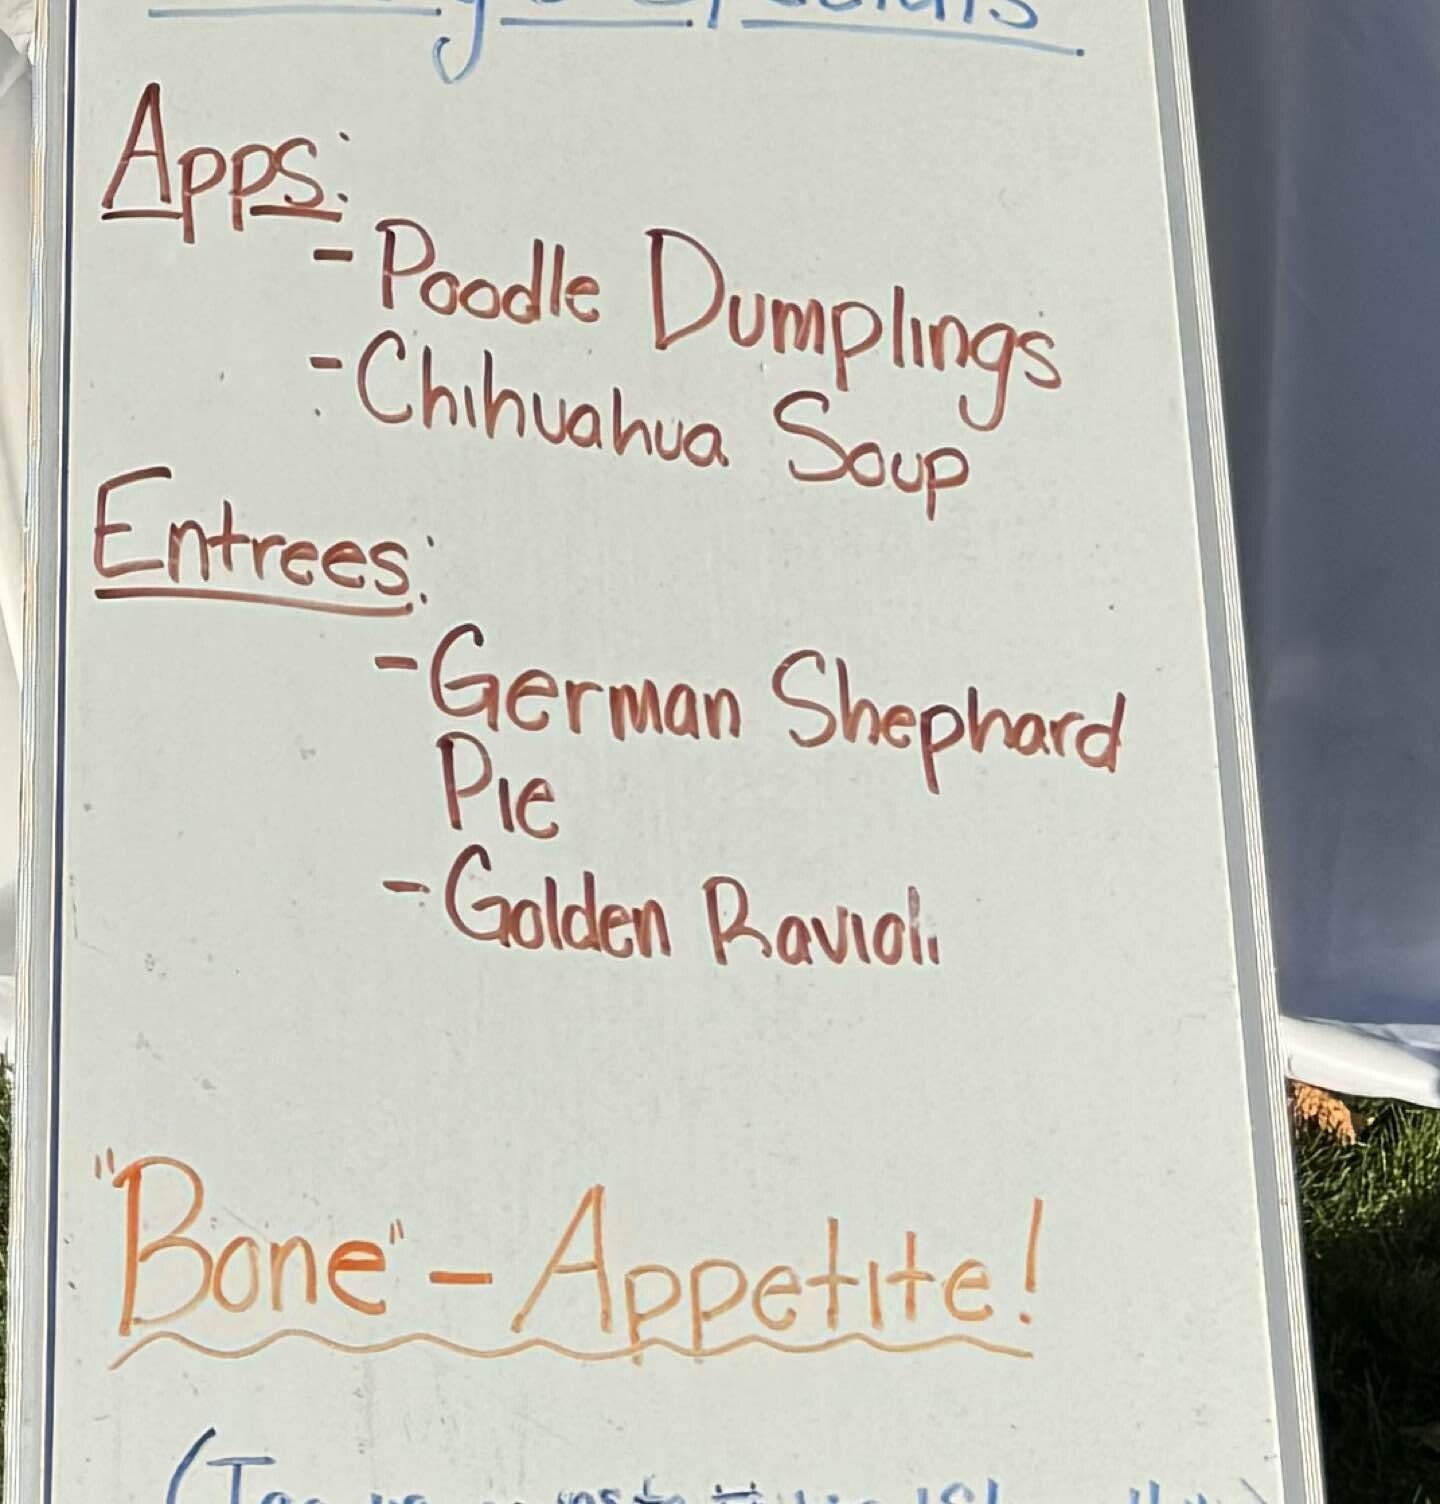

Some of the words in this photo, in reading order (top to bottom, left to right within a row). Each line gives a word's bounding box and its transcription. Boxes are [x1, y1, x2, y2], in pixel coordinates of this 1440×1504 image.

[102, 81, 351, 244] Apps:
[647, 228, 1063, 433] Dumplings
[772, 388, 970, 520] Soup
[93, 466, 436, 606] Entrees:
[437, 731, 560, 841] Pie
[770, 647, 1126, 795] Shephard
[702, 873, 943, 968] Ravioli
